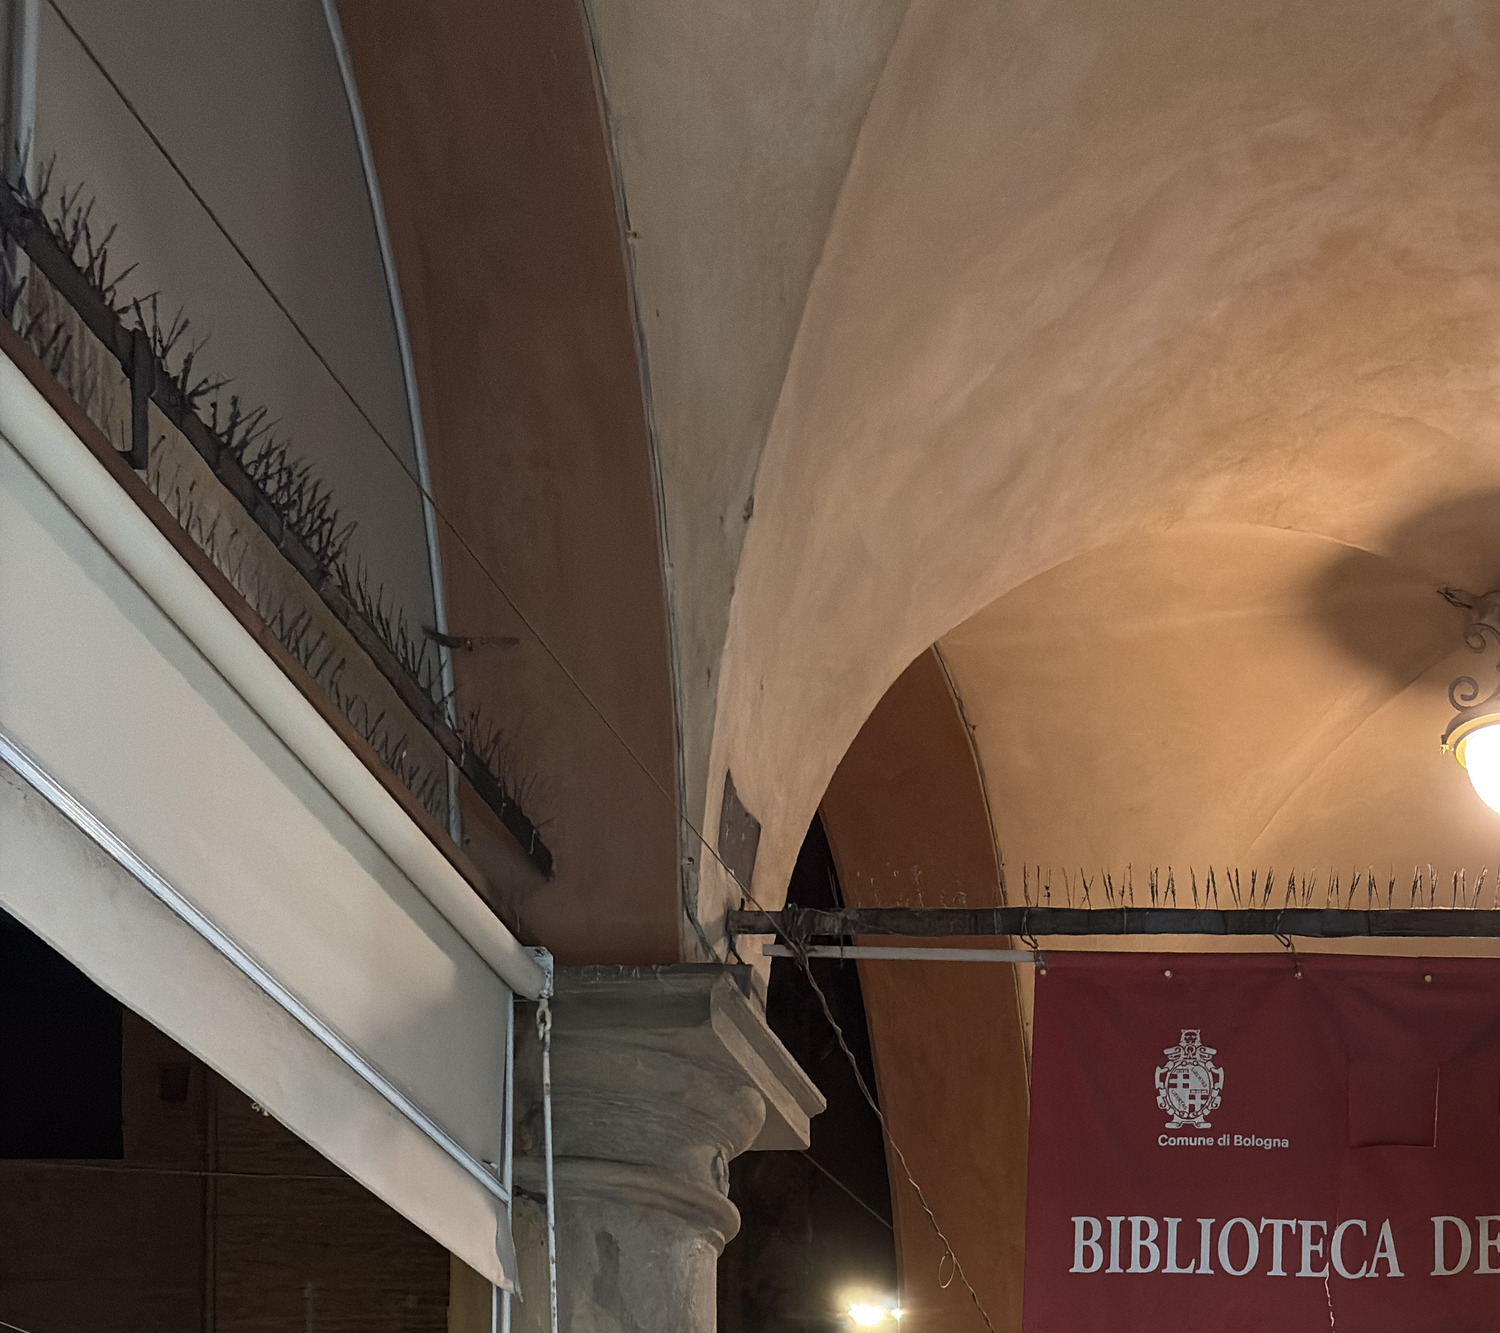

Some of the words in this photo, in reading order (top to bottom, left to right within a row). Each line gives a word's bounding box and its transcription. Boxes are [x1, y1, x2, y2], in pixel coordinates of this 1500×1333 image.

[1158, 1134, 1214, 1146] Comune
[1217, 1134, 1230, 1146] di
[1233, 1134, 1289, 1150] Bologna
[1068, 1215, 1405, 1280] BIBLIOTECA
